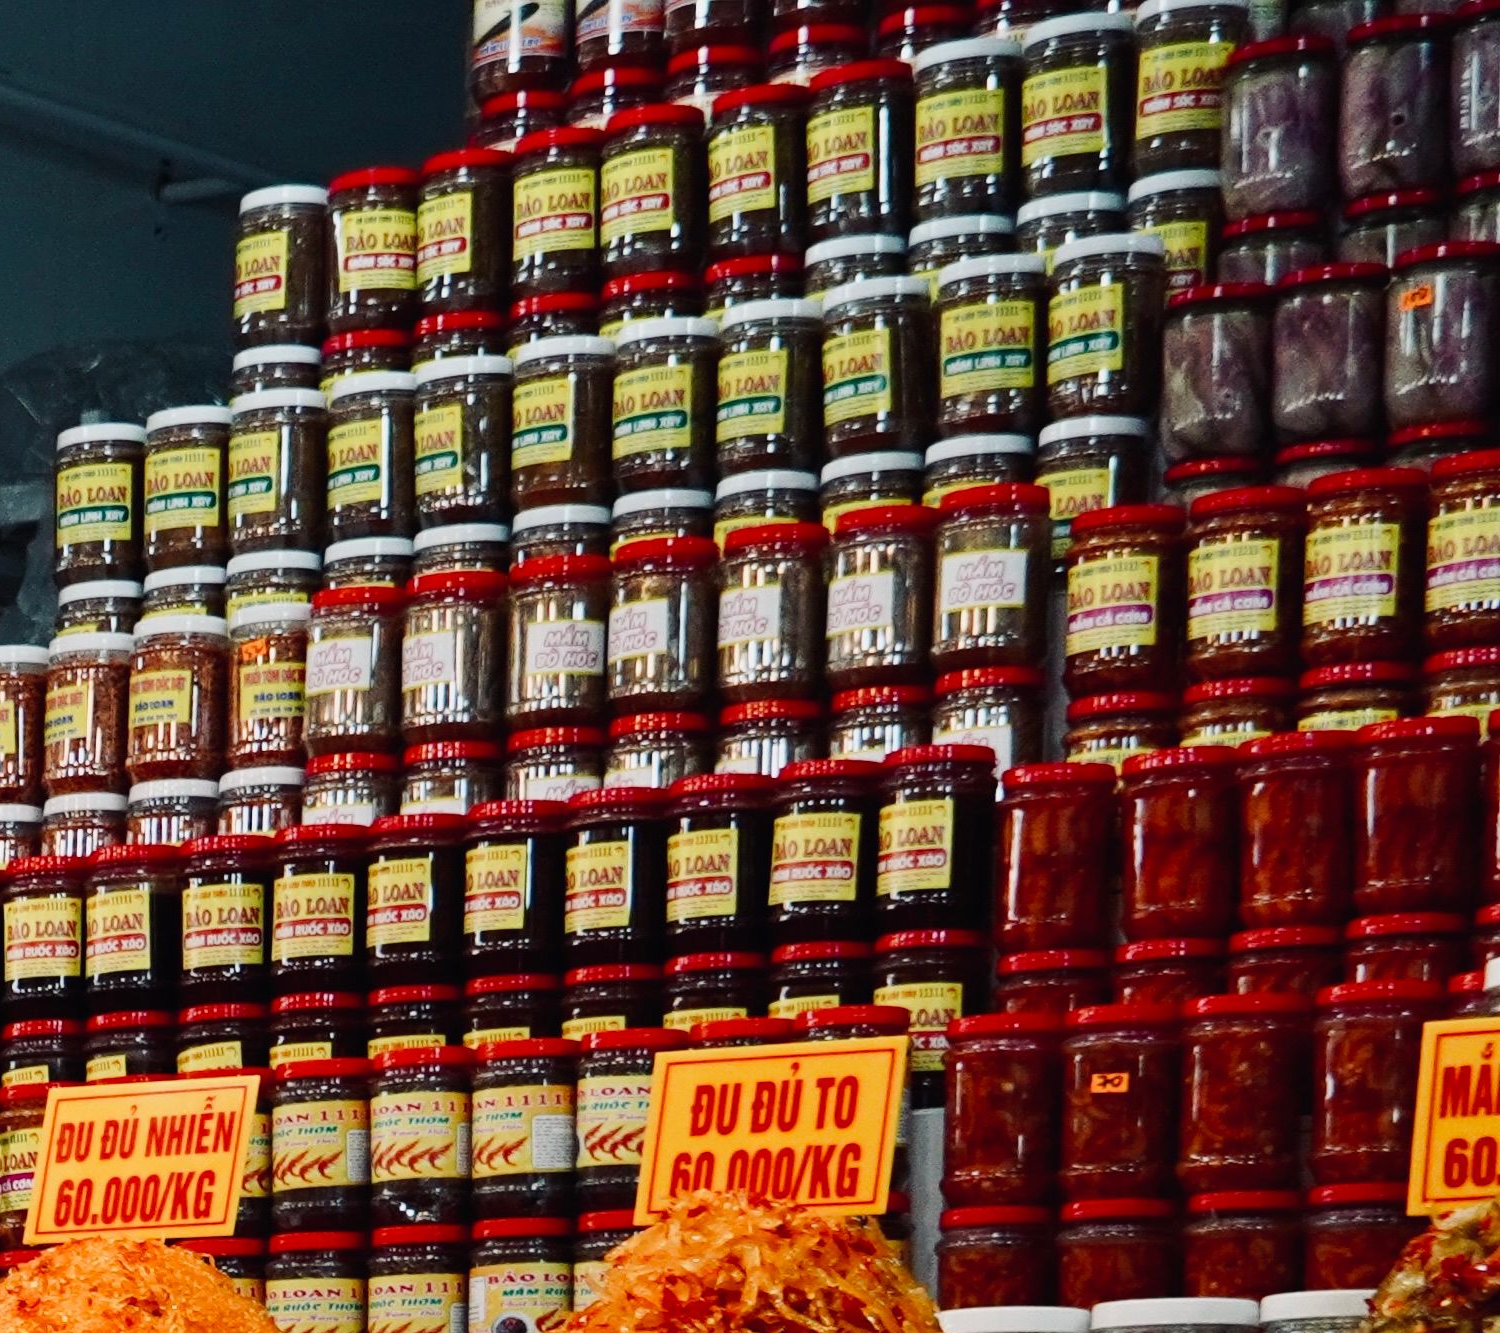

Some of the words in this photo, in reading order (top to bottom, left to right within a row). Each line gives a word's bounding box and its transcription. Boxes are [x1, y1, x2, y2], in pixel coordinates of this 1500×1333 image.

[805, 833, 854, 859] LOAN
[36, 919, 78, 939] LOAN
[306, 892, 352, 916] LOAN
[689, 1081, 745, 1137] ĐU
[750, 1061, 805, 1134] ĐỦ
[812, 1076, 858, 1130] TO
[1439, 1041, 1500, 1120] MẮ
[55, 1121, 97, 1163] ĐU
[100, 1103, 142, 1160] ĐỦ
[53, 1170, 216, 1229] 60.000/KG
[669, 1141, 861, 1202] 60000/KG
